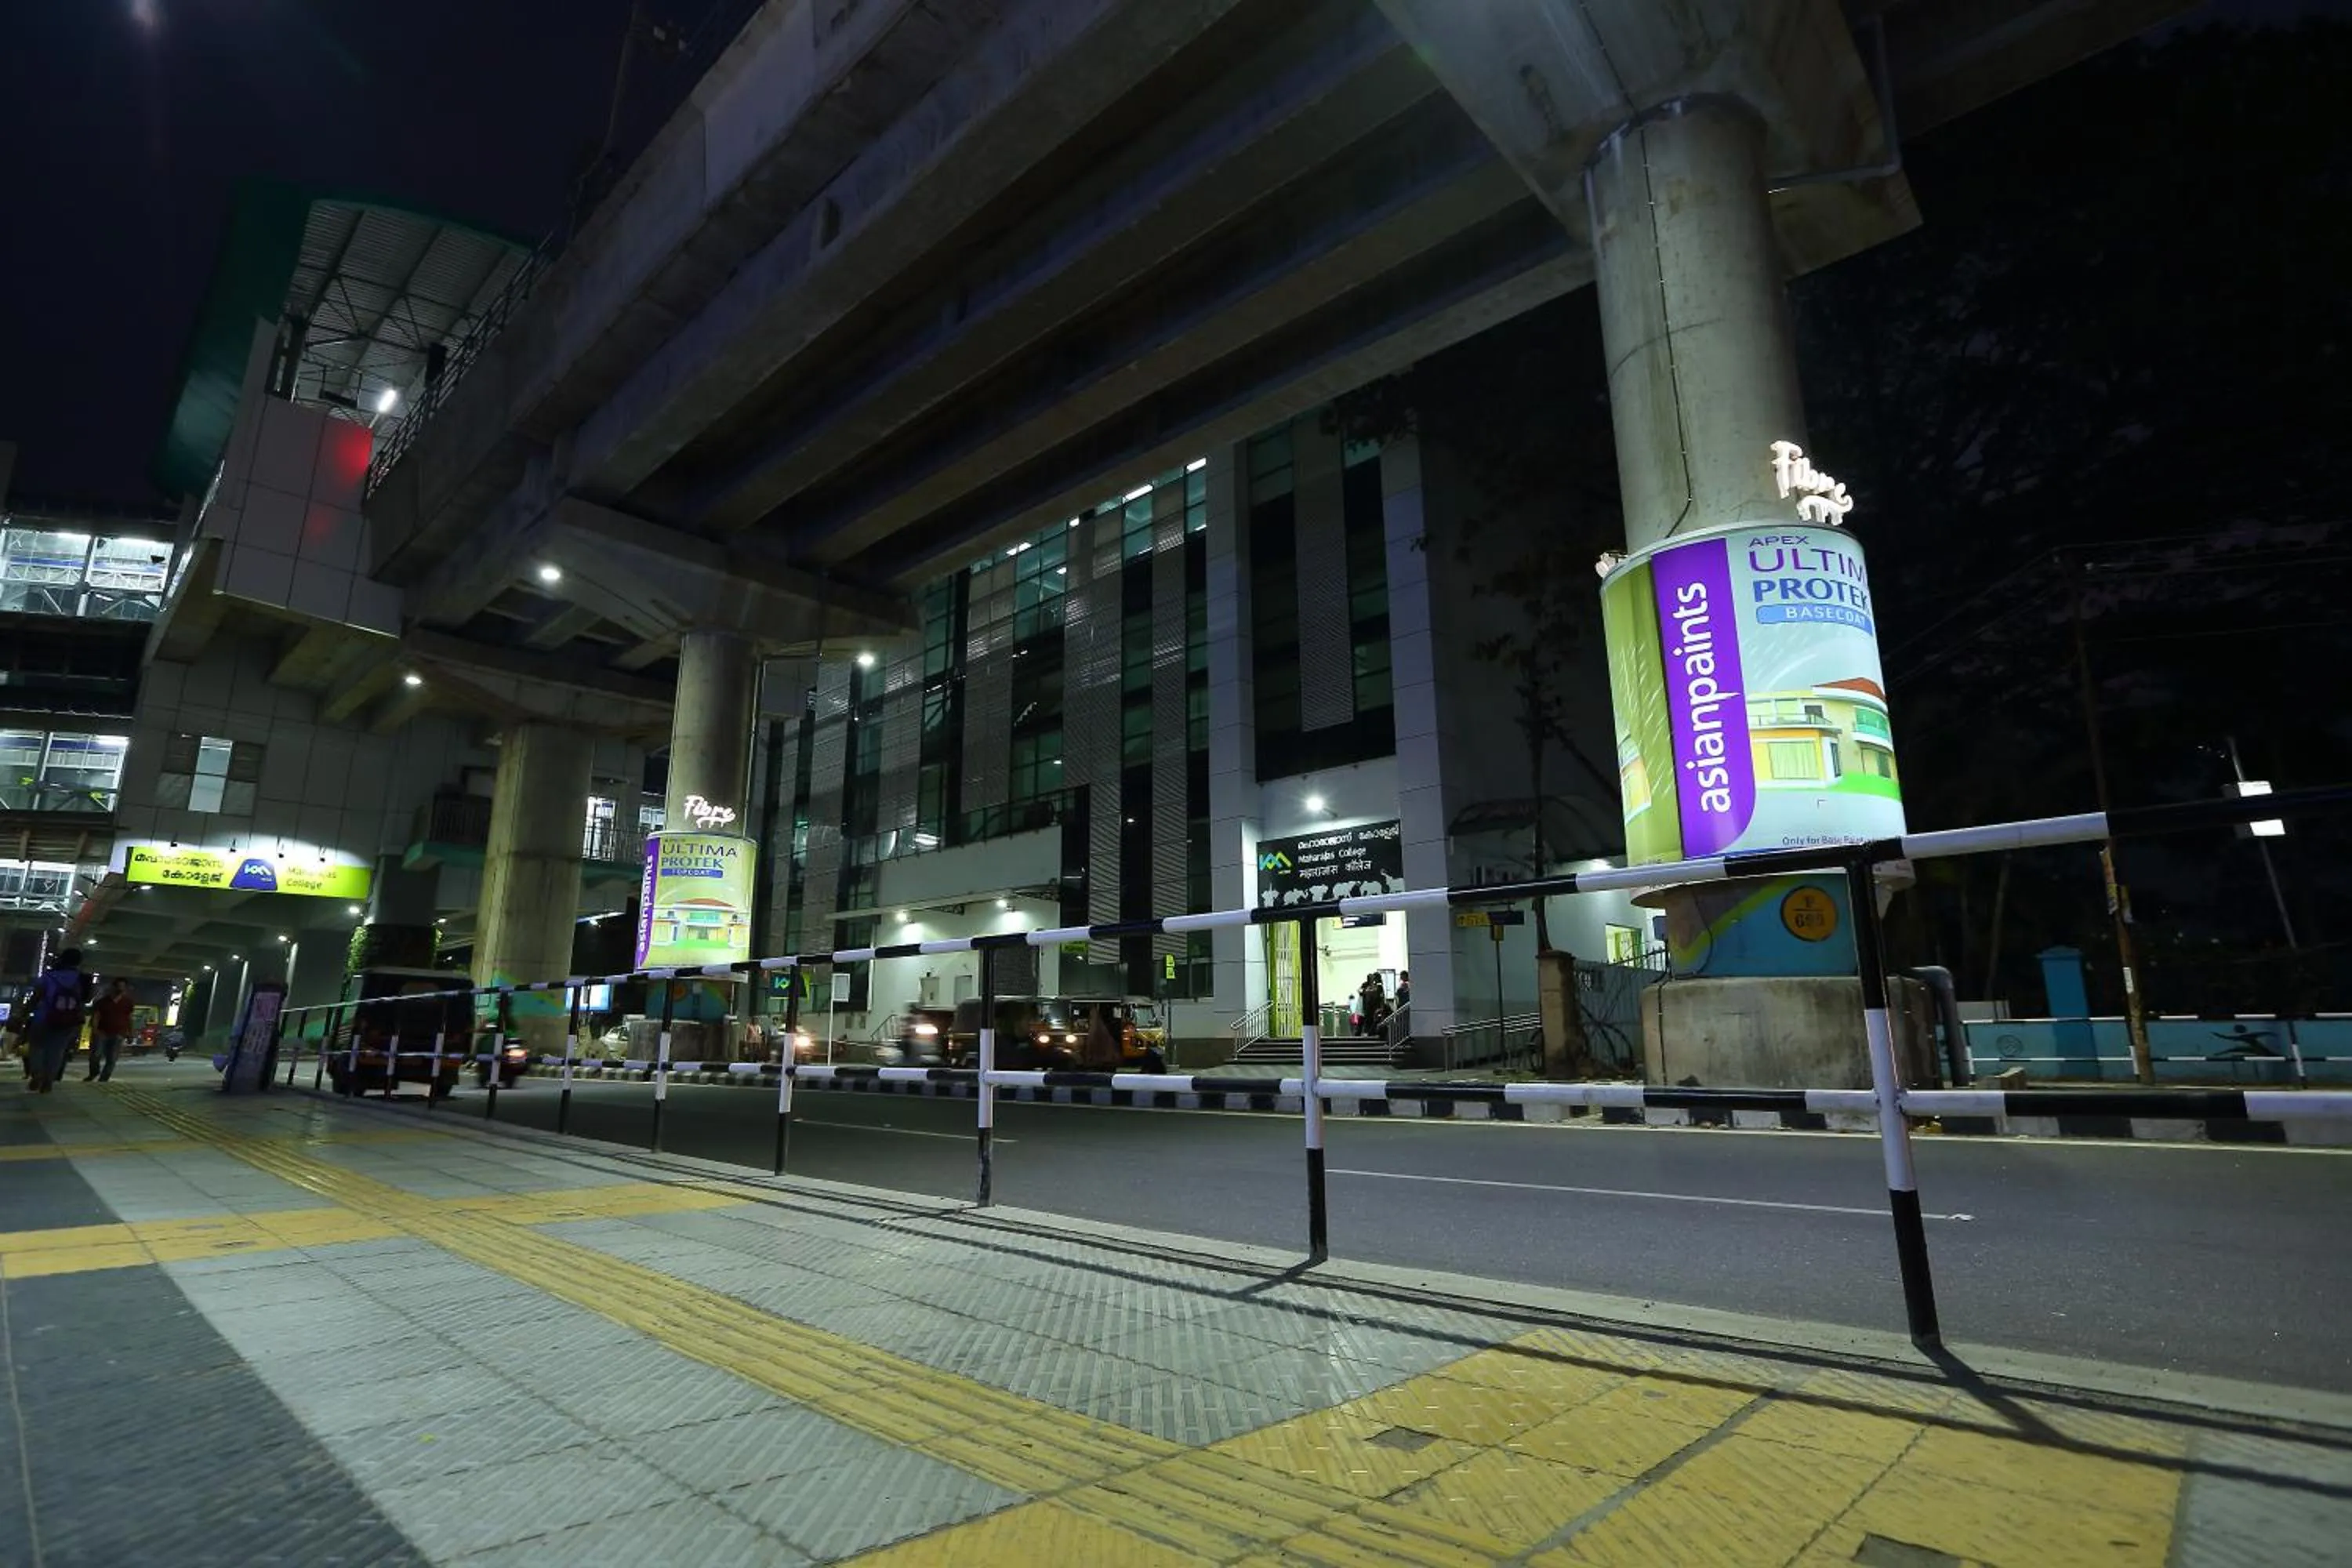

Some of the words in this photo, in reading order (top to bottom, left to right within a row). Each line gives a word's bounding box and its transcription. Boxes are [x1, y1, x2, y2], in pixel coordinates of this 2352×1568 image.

[1748, 535, 1809, 547] APEX
[1785, 608, 1866, 626] BASECOAT
[1673, 582, 1740, 813] asianpaints
[1782, 836, 1805, 845] Only
[1806, 835, 1820, 844] for
[662, 842, 737, 858] ULTIMA
[1338, 847, 1367, 858] College
[661, 856, 724, 869] PROTEK
[286, 878, 322, 890] College
